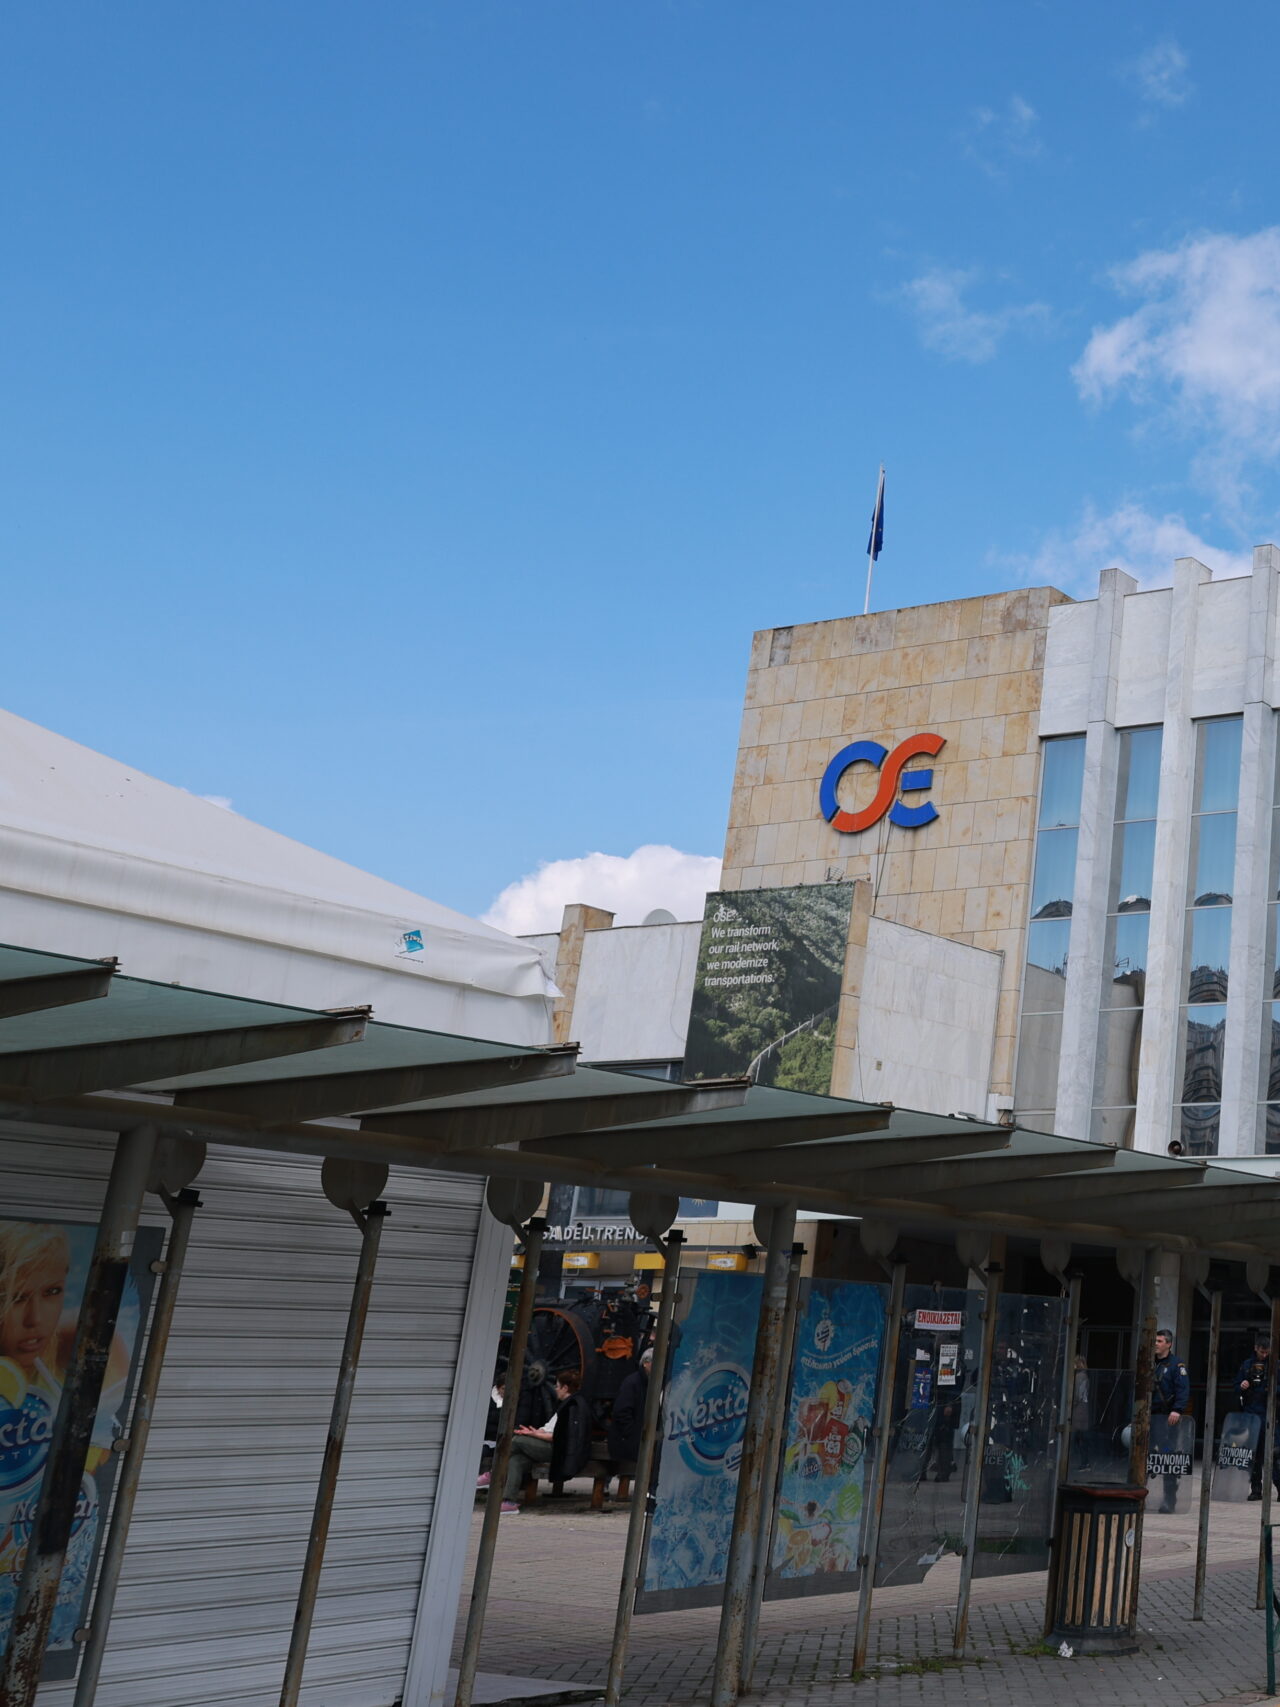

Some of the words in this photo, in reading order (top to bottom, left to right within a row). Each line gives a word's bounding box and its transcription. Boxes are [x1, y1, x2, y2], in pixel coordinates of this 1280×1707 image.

[711, 927, 726, 938] We
[727, 924, 771, 937] transform
[708, 945, 725, 954] our
[725, 941, 740, 953] rail
[740, 939, 780, 952] network,
[706, 962, 720, 970] we
[721, 957, 769, 969] modernize
[563, 1226, 590, 1240] DEL
[985, 1456, 1003, 1465] ICE
[1218, 1457, 1249, 1468] POLICE
[1146, 1465, 1188, 1475] POLICE
